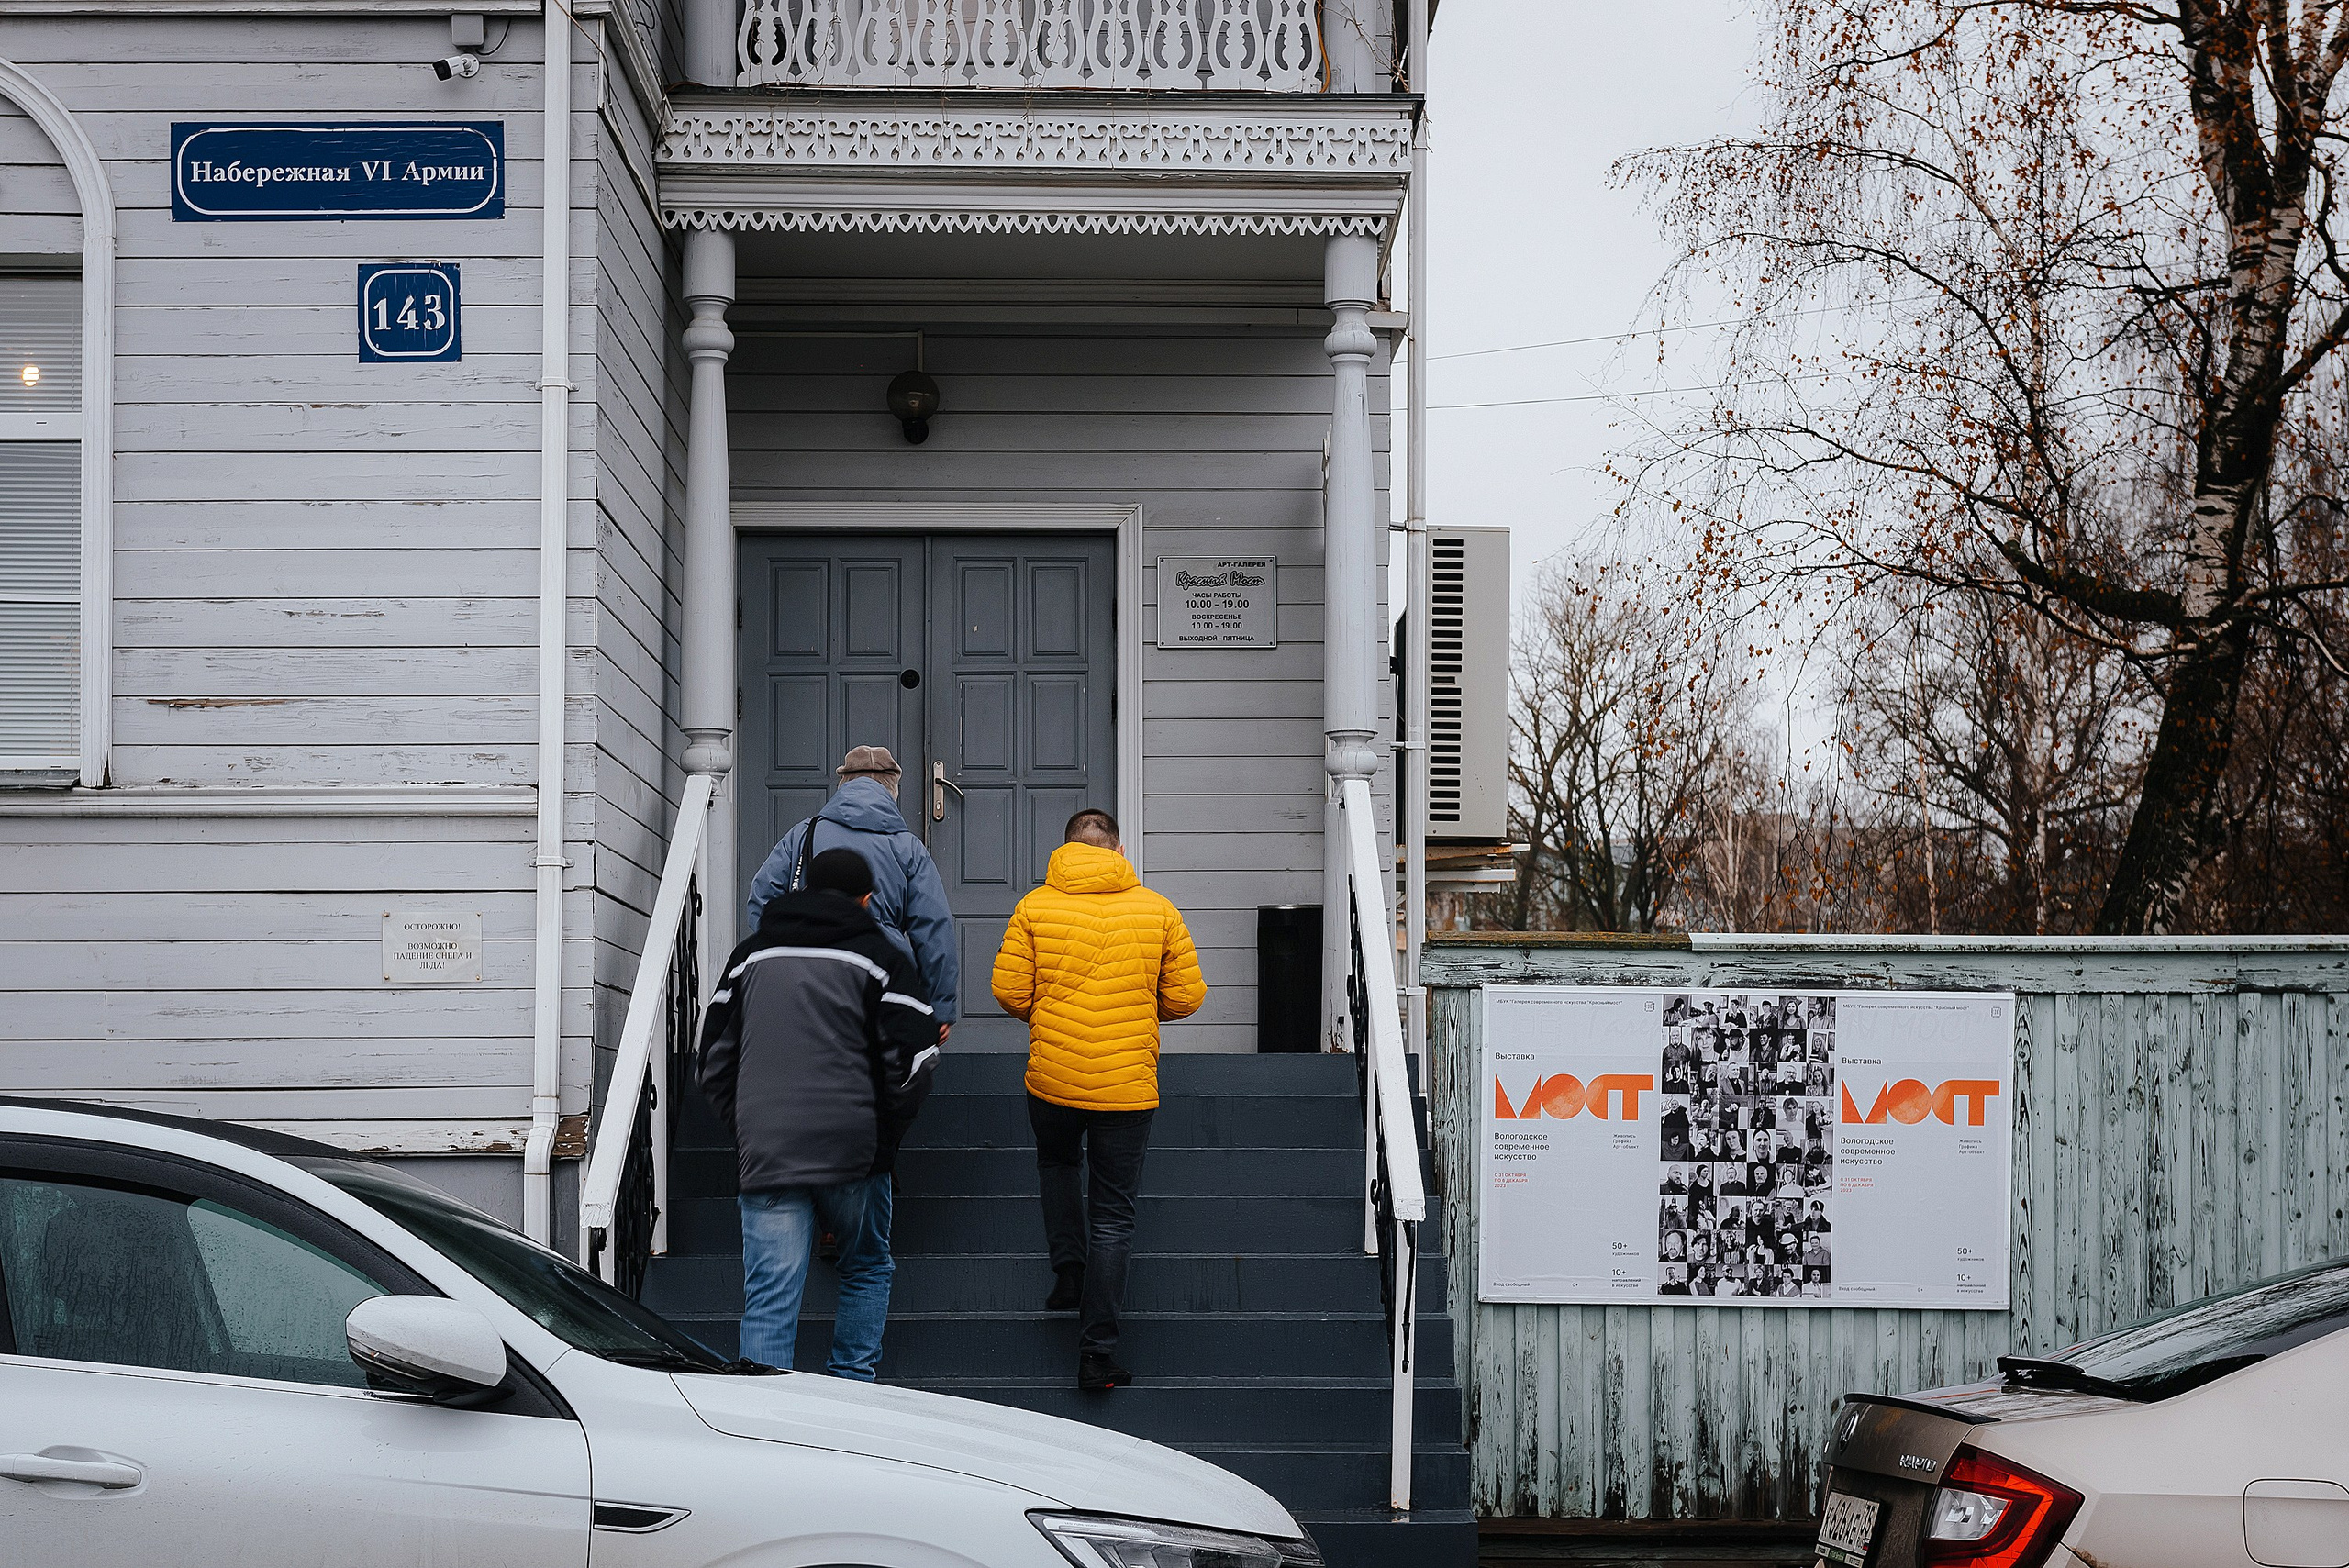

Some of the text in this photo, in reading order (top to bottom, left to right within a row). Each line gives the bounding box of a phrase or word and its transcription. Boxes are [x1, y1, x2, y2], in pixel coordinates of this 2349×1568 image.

[190, 160, 484, 187] Набережная VI Армии
[373, 295, 445, 330] 143
[1175, 570, 1266, 591] Красный Мост
[1186, 599, 1212, 609] 10.00
[1222, 599, 1250, 609] 19.00
[419, 962, 445, 970] ЛЬДА!
[1495, 1051, 1534, 1061] Выставка
[1842, 1057, 1882, 1065] Выставка
[1495, 1073, 1653, 1121] МОСТ
[1841, 1078, 2000, 1126] МОСТ
[1494, 1132, 1548, 1140] Вологодское
[1841, 1137, 1894, 1146] Вологодское
[1841, 1148, 1896, 1156] современное
[1494, 1153, 1537, 1162] искусство
[1840, 1158, 1883, 1166] искусство
[1899, 1454, 1937, 1472] RAPID
